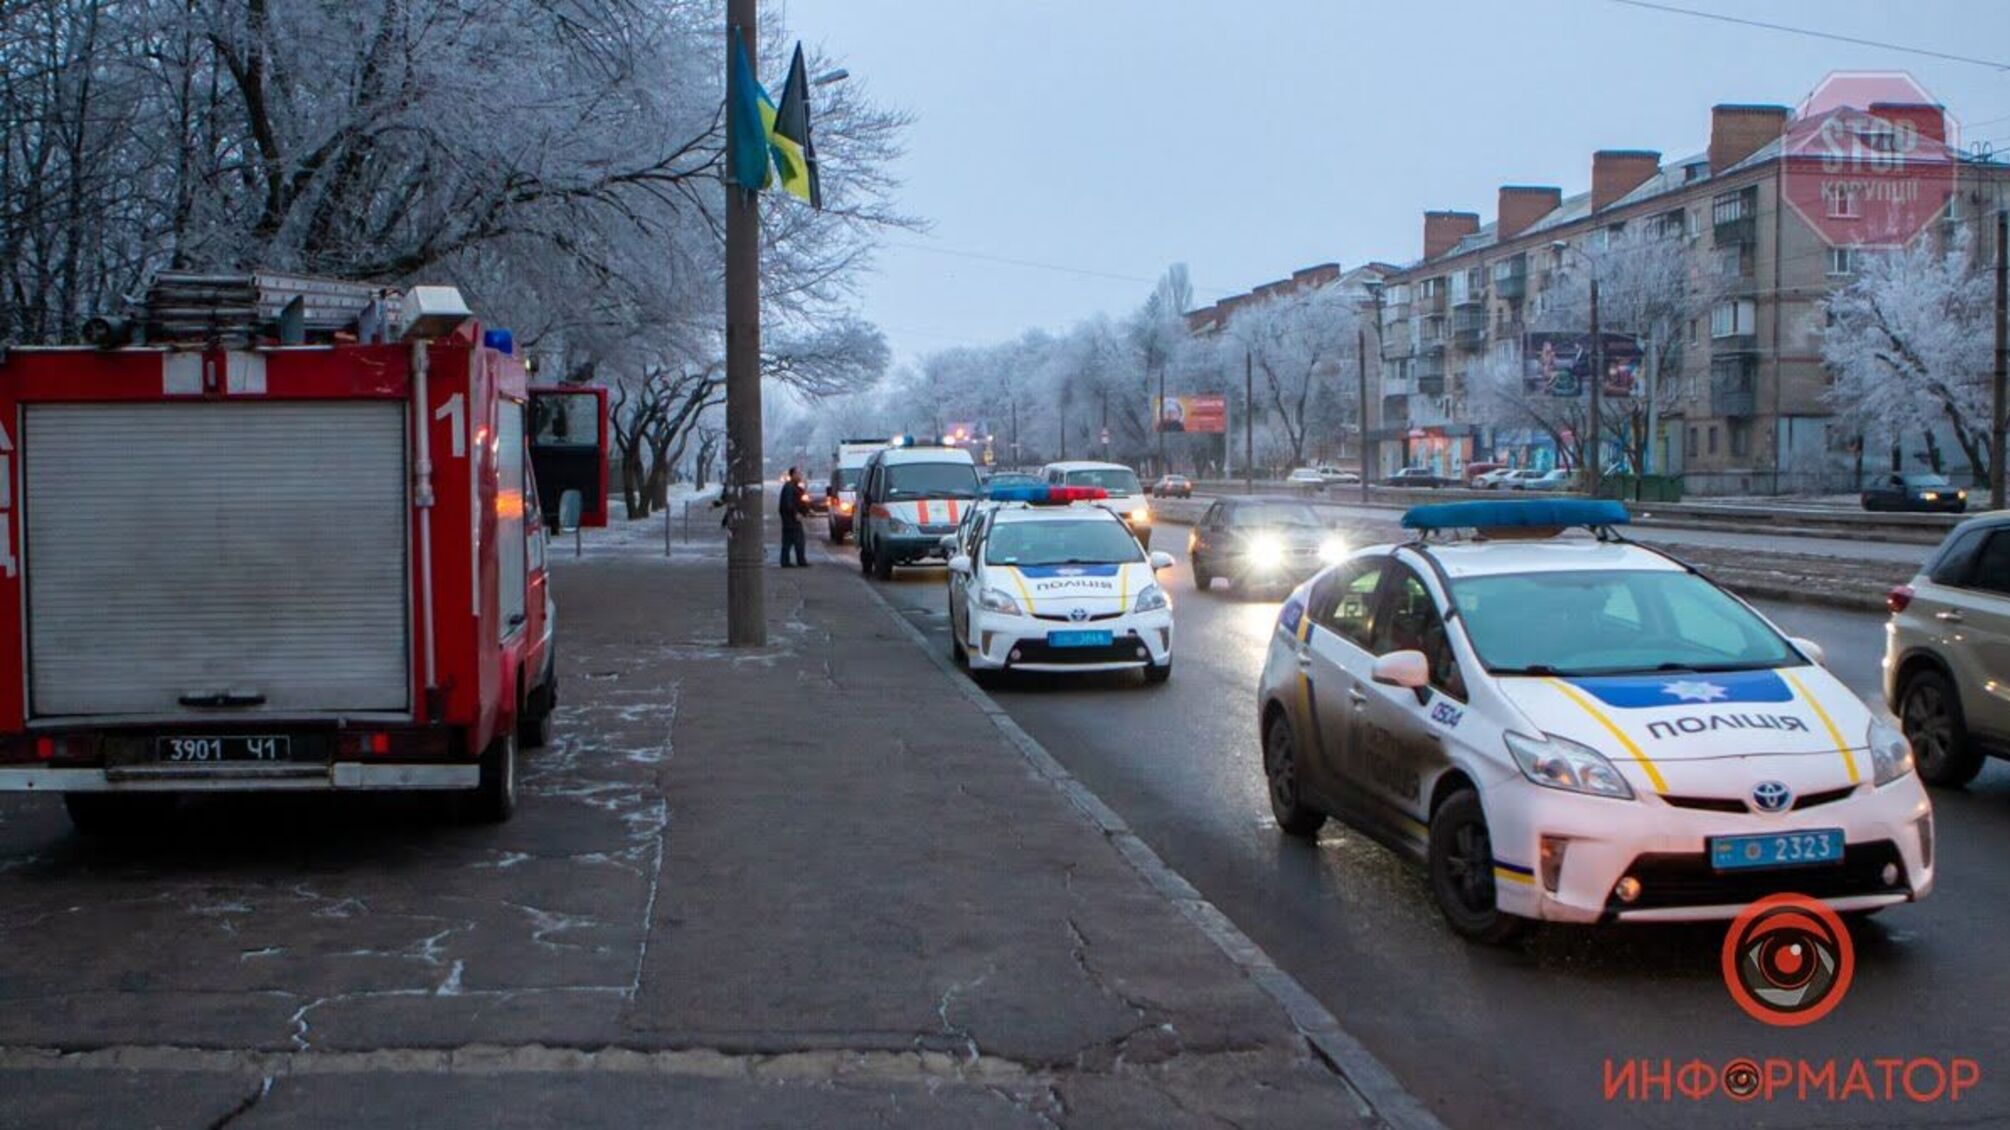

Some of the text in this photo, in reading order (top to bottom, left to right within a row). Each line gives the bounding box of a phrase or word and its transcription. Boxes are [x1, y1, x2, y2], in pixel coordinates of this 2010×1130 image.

[435, 392, 466, 458] 1
[1646, 713, 1810, 740] ПОЛІЦІЯ
[170, 739, 221, 760] 3901
[1775, 834, 1830, 860] 2323
